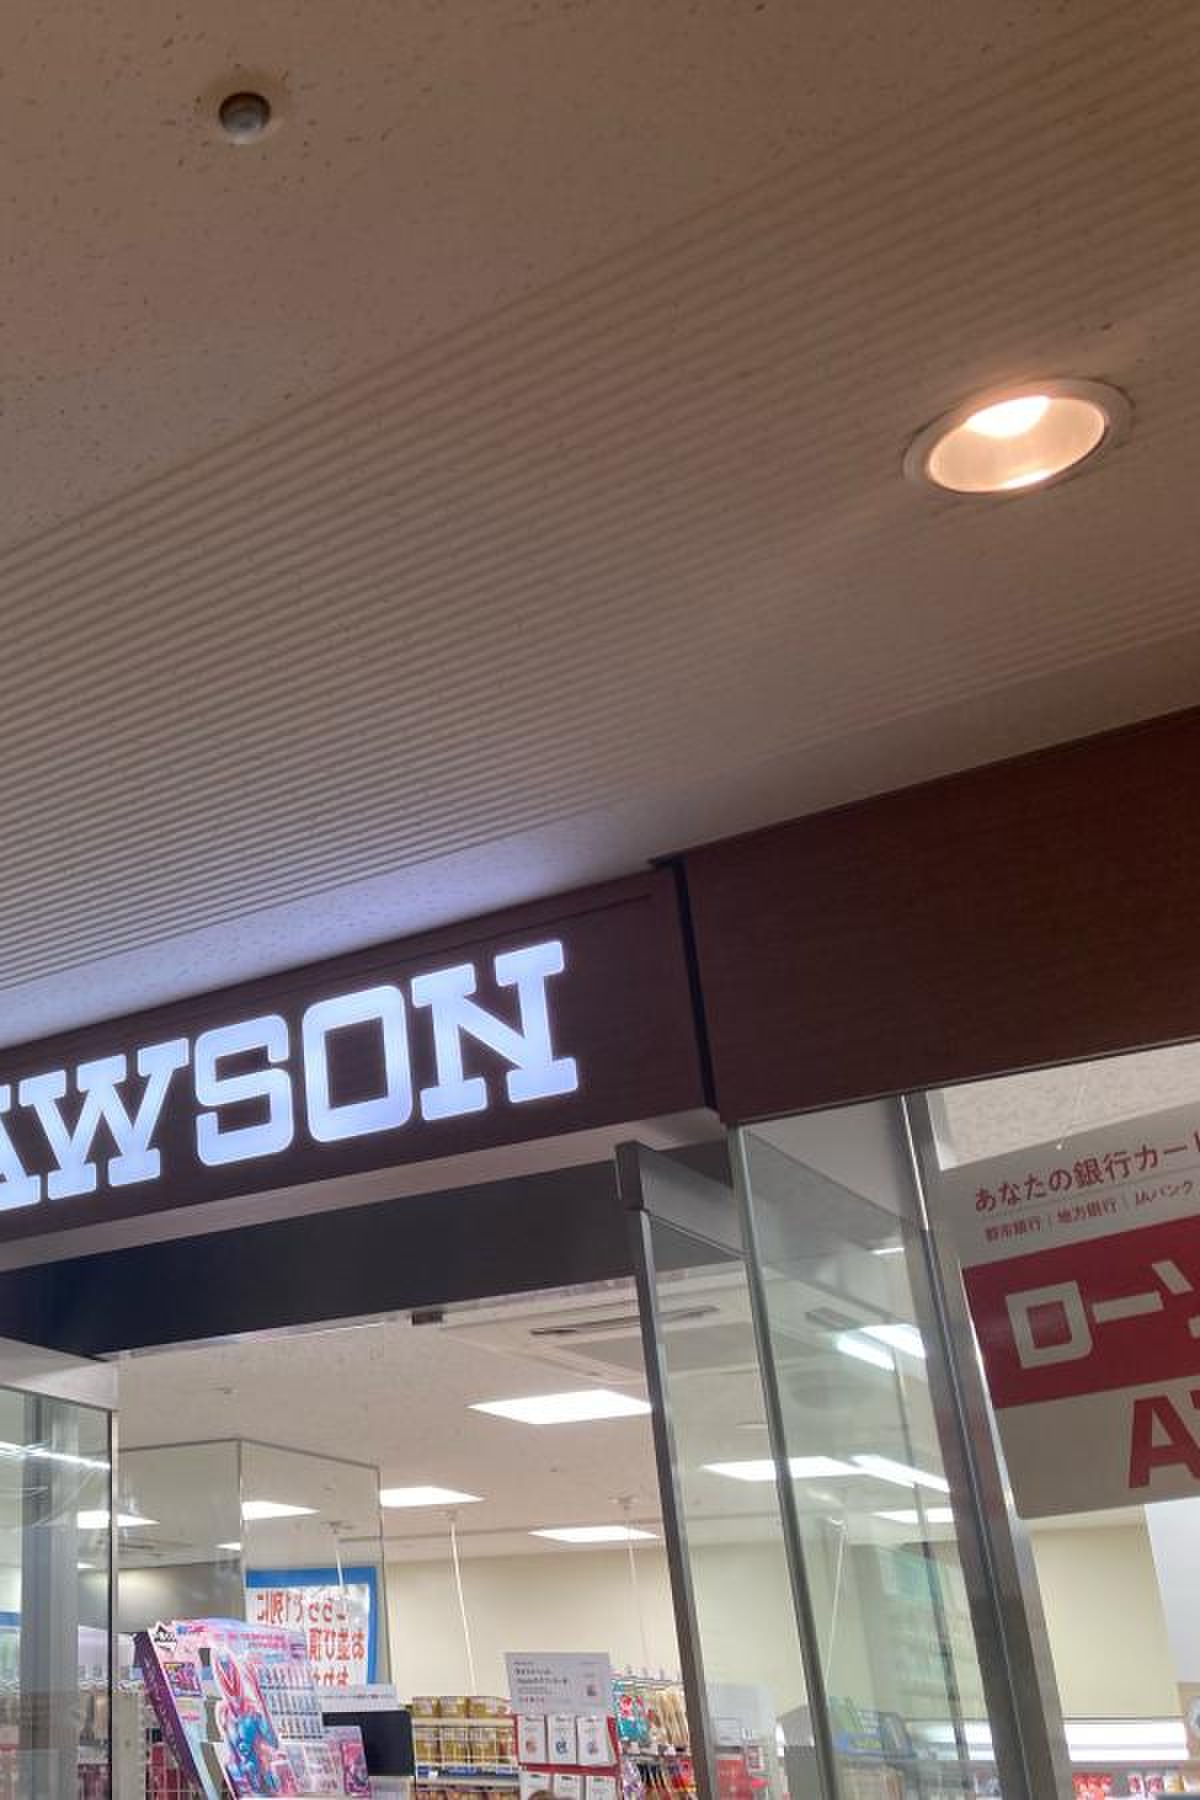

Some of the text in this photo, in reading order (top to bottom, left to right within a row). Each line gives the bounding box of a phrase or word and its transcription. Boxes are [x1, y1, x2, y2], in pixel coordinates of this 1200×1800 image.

[975, 1129, 1200, 1212] あなたの銀行カー
[1128, 1388, 1200, 1489] A
